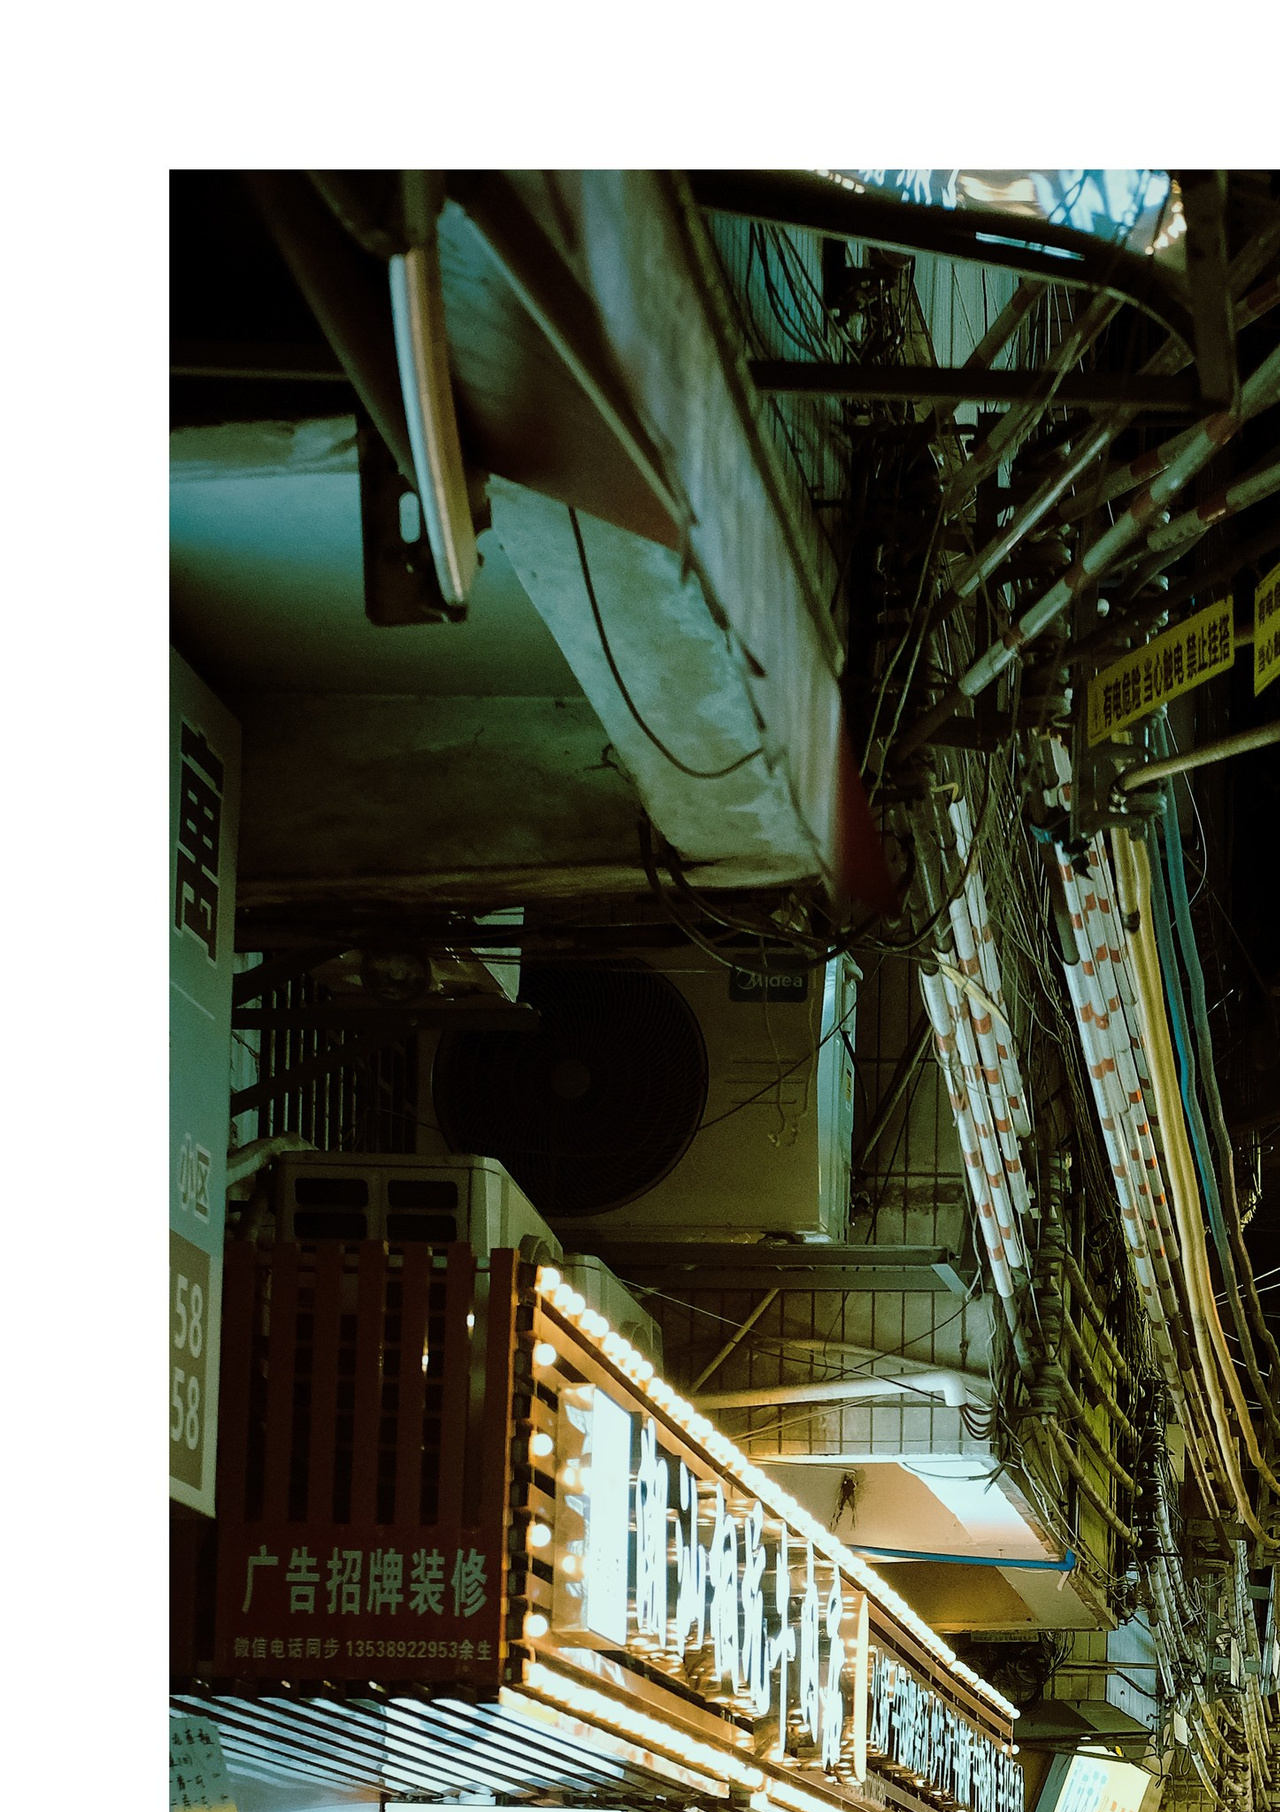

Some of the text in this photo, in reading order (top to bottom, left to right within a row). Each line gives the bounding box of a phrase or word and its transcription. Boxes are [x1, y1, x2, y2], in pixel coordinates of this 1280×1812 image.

[241, 1545, 488, 1618] 广告招牌装修
[233, 1636, 340, 1660] 微信电话同步
